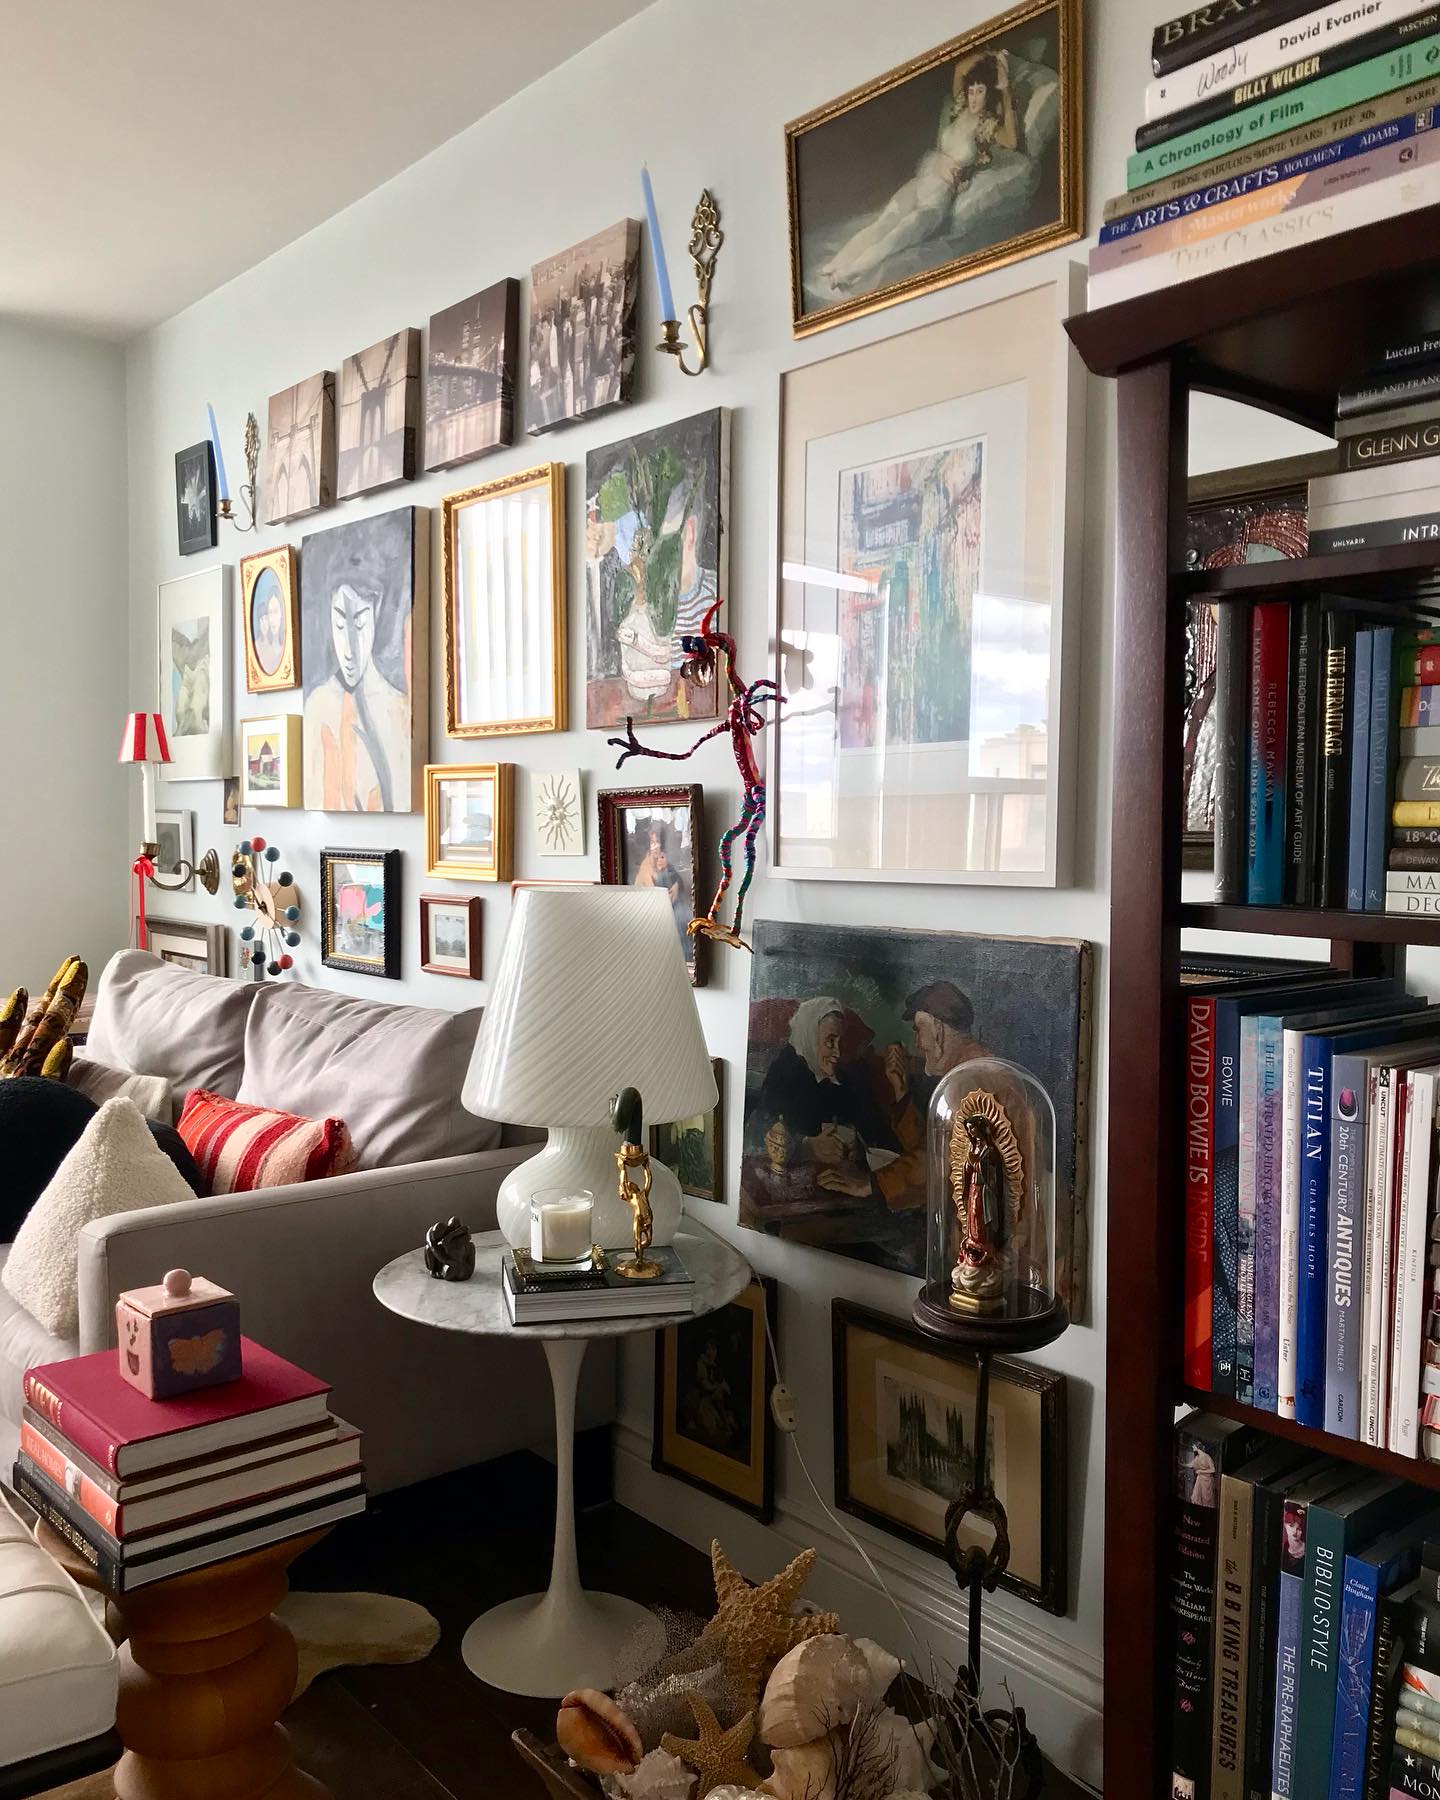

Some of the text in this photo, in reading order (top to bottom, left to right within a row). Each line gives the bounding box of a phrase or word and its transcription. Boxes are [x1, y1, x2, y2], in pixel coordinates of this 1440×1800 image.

[1279, 1, 1382, 50] David Evanier
[1197, 46, 1249, 98] Woody
[1234, 55, 1321, 105] BILLY WILDER
[1144, 160, 1154, 173] A
[1159, 125, 1244, 169] Chronology
[1249, 113, 1265, 130] of
[1270, 99, 1305, 123] Film
[1359, 124, 1400, 148] ADAMS
[1171, 174, 1200, 190] THOSE
[1202, 155, 1252, 179] FABULOUS
[1253, 142, 1287, 161] MOVIE
[1332, 115, 1356, 131] THE
[1111, 144, 1344, 236] THE ARTS & CRAFTS MOVEMENT
[1385, 340, 1440, 360] Lucian Fre
[1357, 432, 1420, 458] GLENN
[1333, 536, 1366, 548] UHLYARIK
[1403, 523, 1440, 541] INTR
[1252, 634, 1262, 671] HAVE
[1252, 679, 1261, 714] SOME
[1324, 646, 1346, 757] THE HERMITAGE
[1265, 683, 1277, 745] REBECCA
[1293, 633, 1308, 864] THE METROPOLITAN MUSEUM OF ART GUIDE
[1327, 768, 1335, 791] GUIDE
[1249, 830, 1257, 858] YOU
[1406, 856, 1439, 865] DEWAN
[1190, 1003, 1211, 1078] DAVID
[1264, 1044, 1275, 1067] THE
[1221, 1056, 1233, 1107] BOWIE
[1264, 1070, 1275, 1153] ILLUSTRATED
[1379, 1091, 1387, 1117] UNCUT
[1188, 1082, 1210, 1163] BOWIE
[1377, 1135, 1386, 1169] ULTIMATE
[1189, 1167, 1209, 1185] IS
[1263, 1156, 1274, 1206] HISTORY
[1305, 1067, 1324, 1279] TITIAN CHARLES HOPE
[1334, 1126, 1353, 1308] 20th CENTURY ANTIQUES
[1375, 1212, 1383, 1240] EDITION
[1410, 1249, 1418, 1282] KINFOLK
[1283, 1338, 1291, 1363] Lister
[1336, 1310, 1346, 1373] MARTIN MILLER
[1370, 1365, 1378, 1377] THE
[1369, 1378, 1377, 1405] MAKERS
[1336, 1394, 1345, 1423] CARLTON
[1368, 1416, 1376, 1443] UNCUT
[1183, 1514, 1201, 1528] New
[1183, 1571, 1196, 1582] The
[1224, 1581, 1243, 1596] B
[1349, 1577, 1371, 1593] Claire
[1224, 1599, 1242, 1613] B
[1344, 1583, 1375, 1603] Bingham
[1171, 1605, 1214, 1623] AKESPEARE
[1222, 1616, 1242, 1661] KING
[1282, 1645, 1296, 1674] THE
[1218, 1666, 1240, 1772] TREASURES
[1277, 1675, 1296, 1796] PRE-RAPHAELITES
